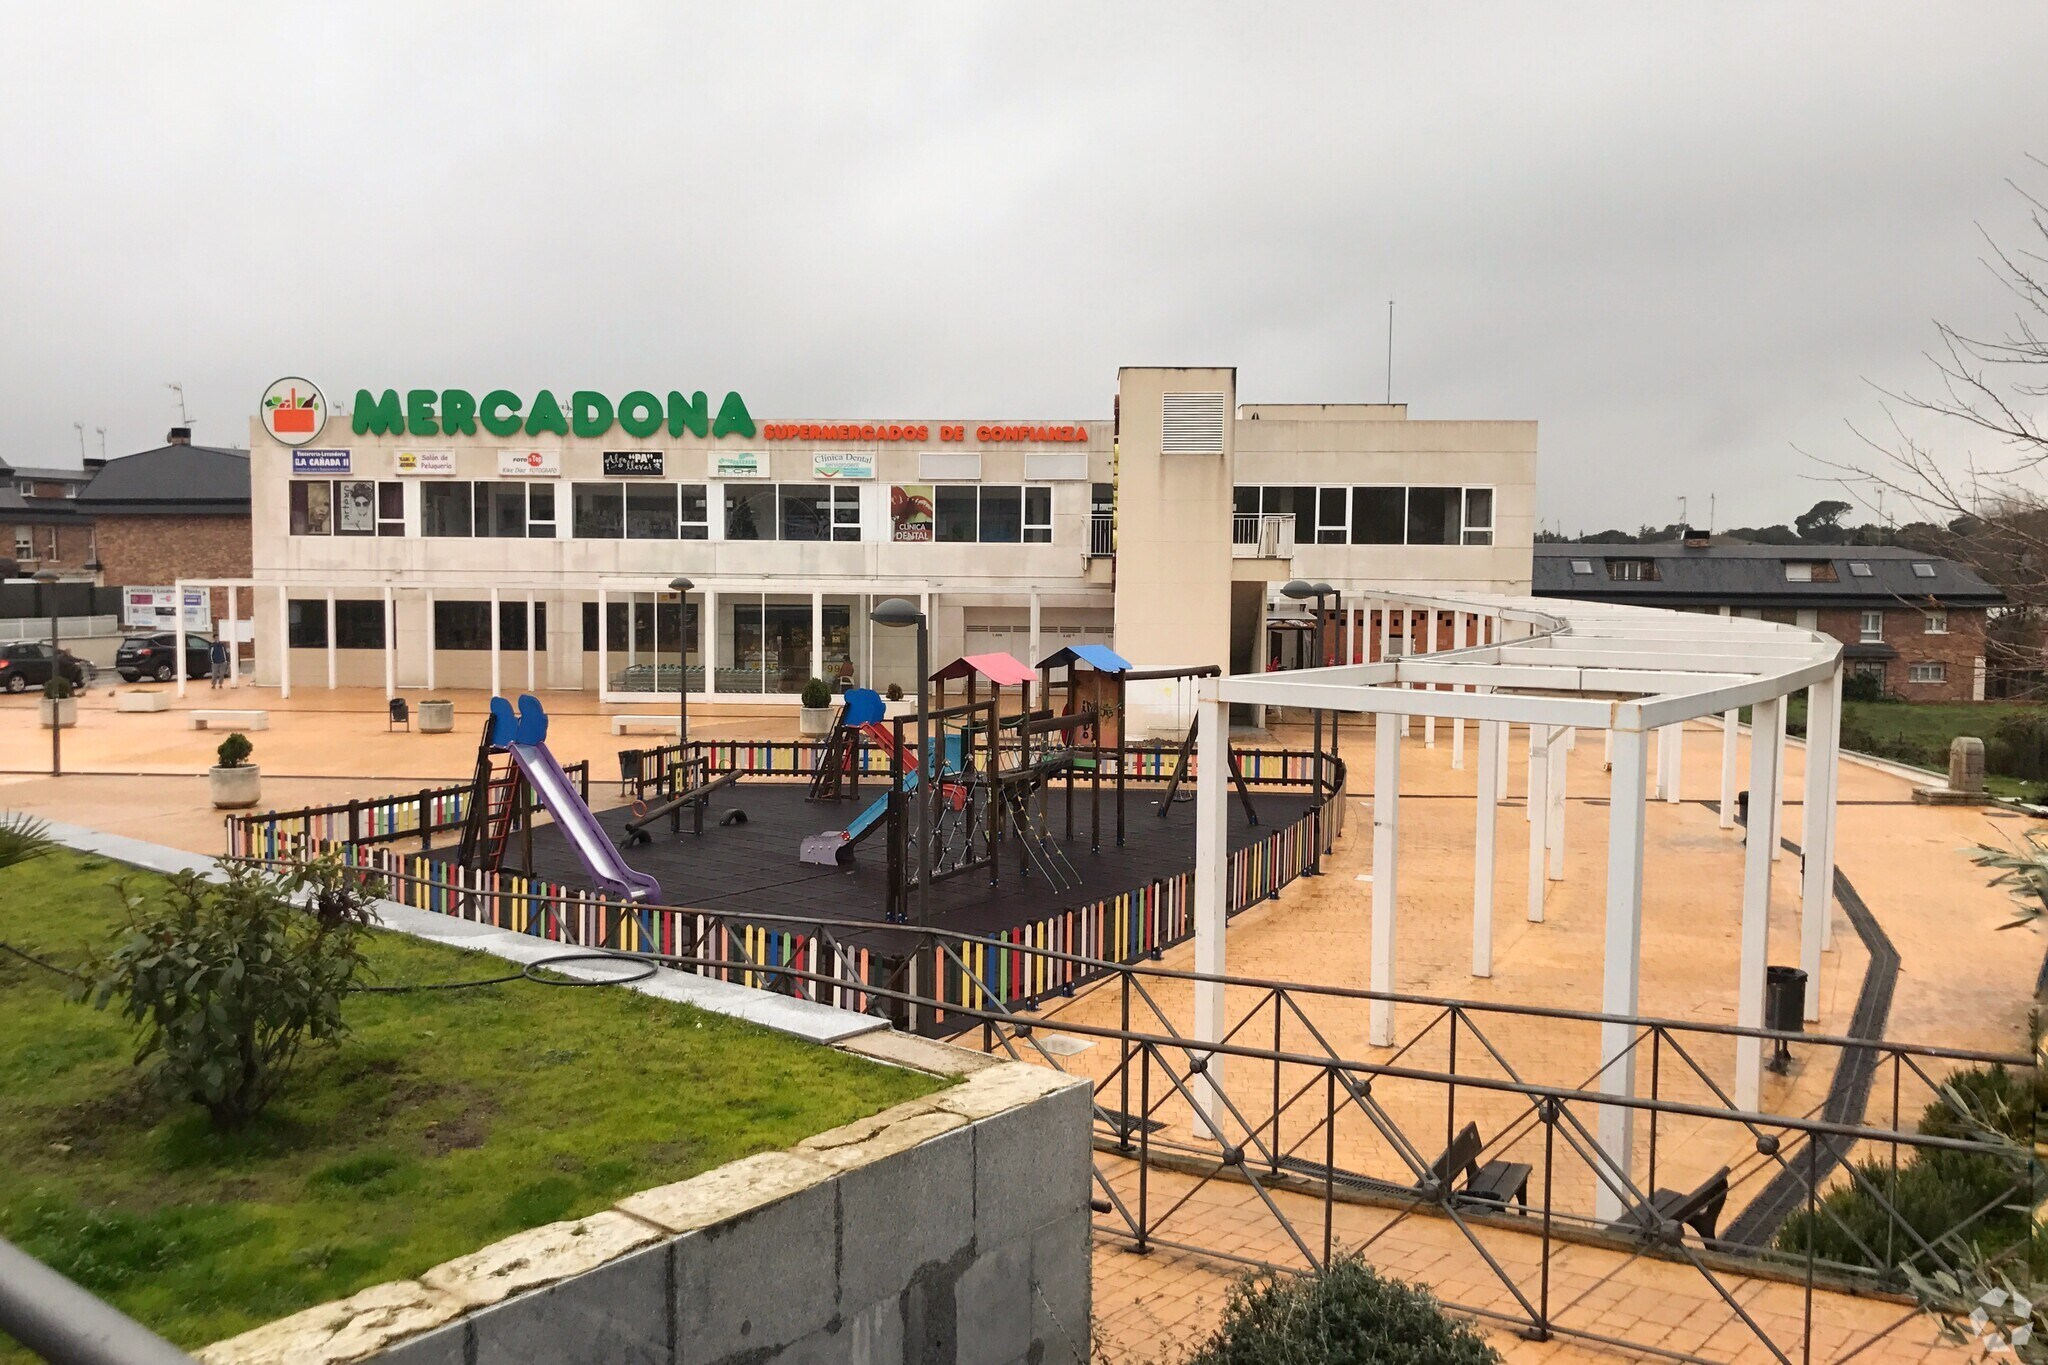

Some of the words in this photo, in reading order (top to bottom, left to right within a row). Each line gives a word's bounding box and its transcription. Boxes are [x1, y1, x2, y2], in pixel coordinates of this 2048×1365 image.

[352, 388, 756, 438] MERCADONA
[764, 424, 929, 441] SUPERMERCADOS
[940, 425, 965, 442] DE
[976, 426, 1089, 443] CONFIANZA
[295, 458, 307, 466] LA
[309, 456, 341, 466] CAÑADA
[845, 453, 872, 464] Dental
[896, 531, 929, 541] DENTAL
